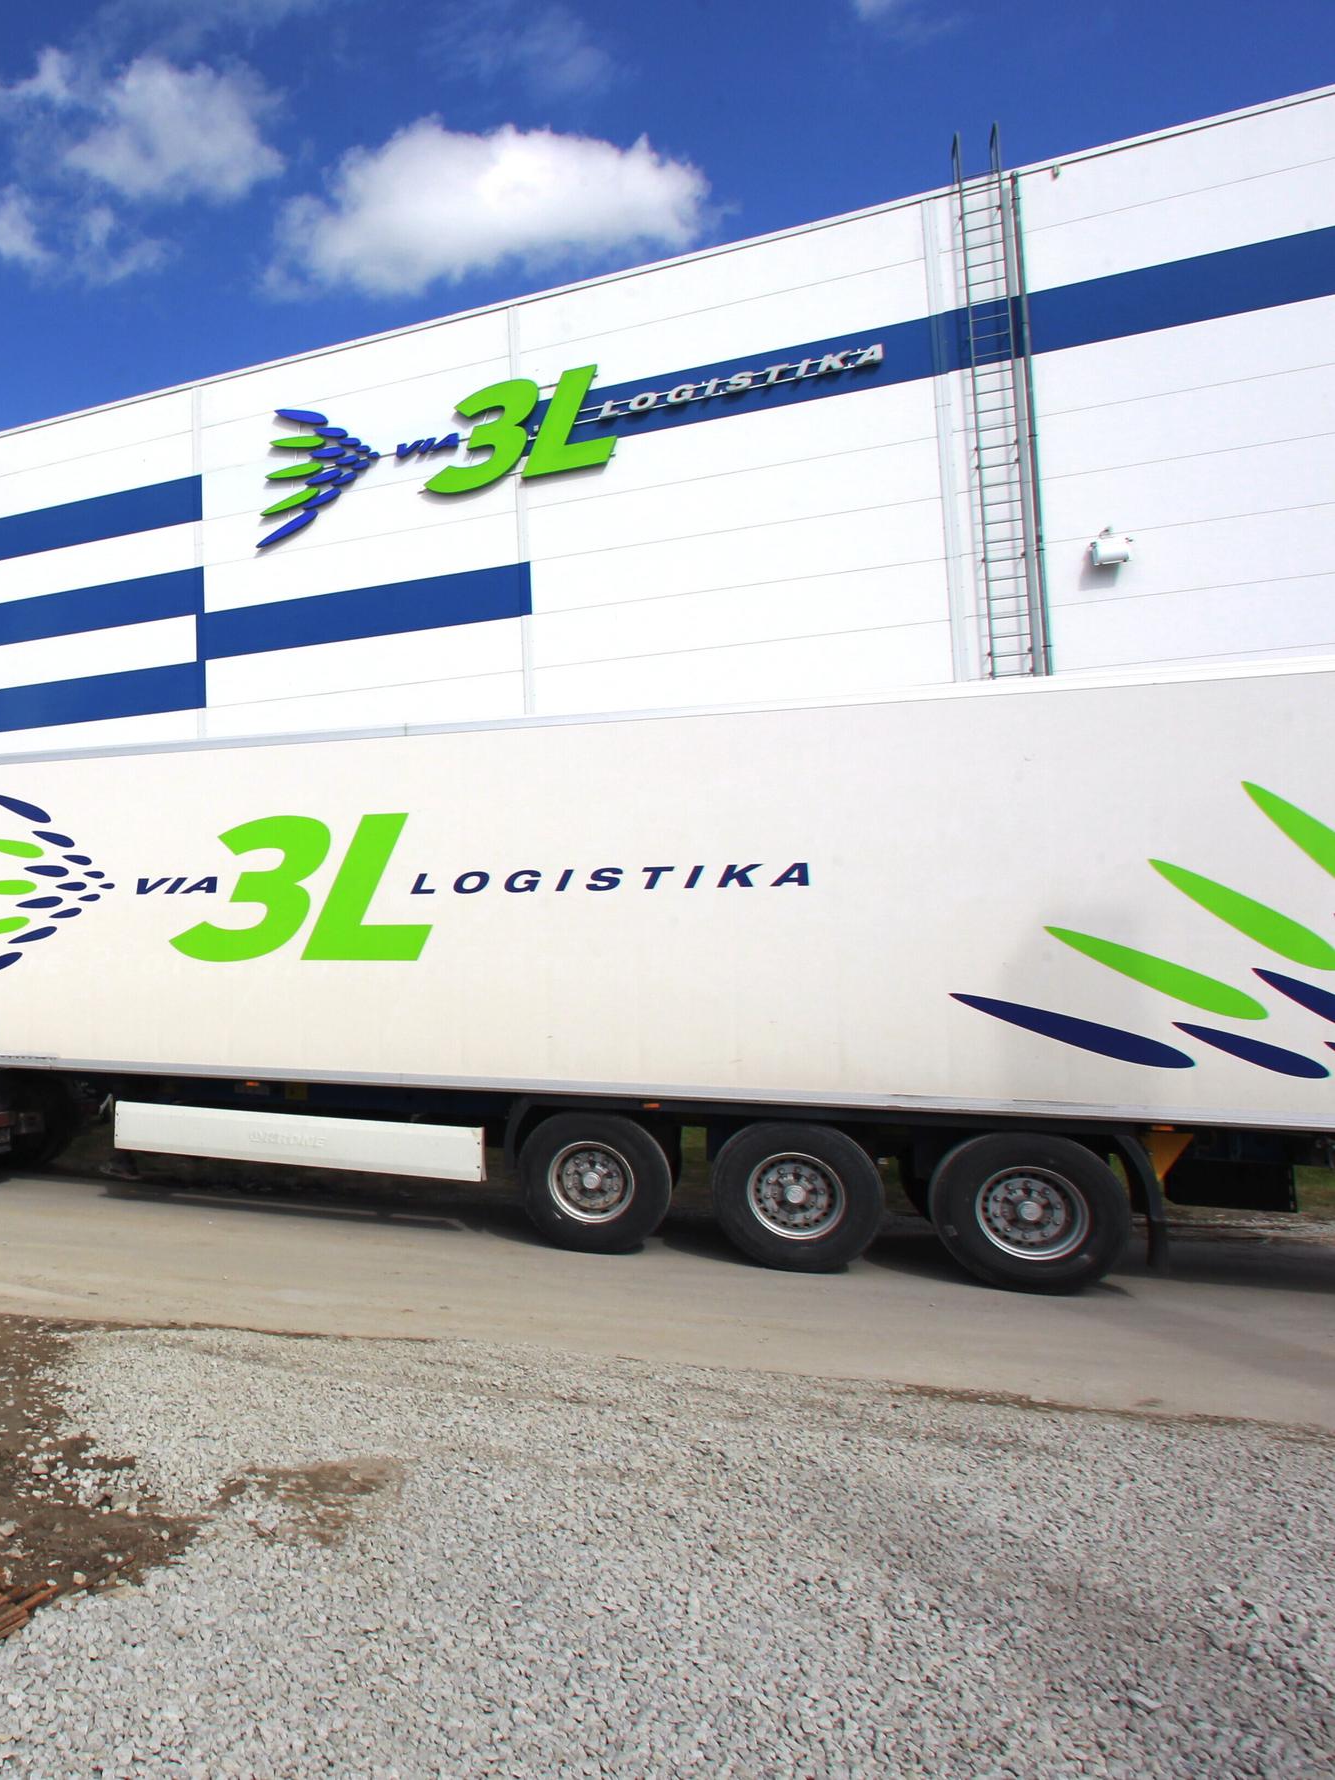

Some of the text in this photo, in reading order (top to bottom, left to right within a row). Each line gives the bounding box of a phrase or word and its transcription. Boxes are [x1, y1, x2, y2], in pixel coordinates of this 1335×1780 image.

[396, 343, 884, 494] VIA 3L LOGISTIKA
[134, 812, 812, 962] VIA 3L LOGISTIKA
